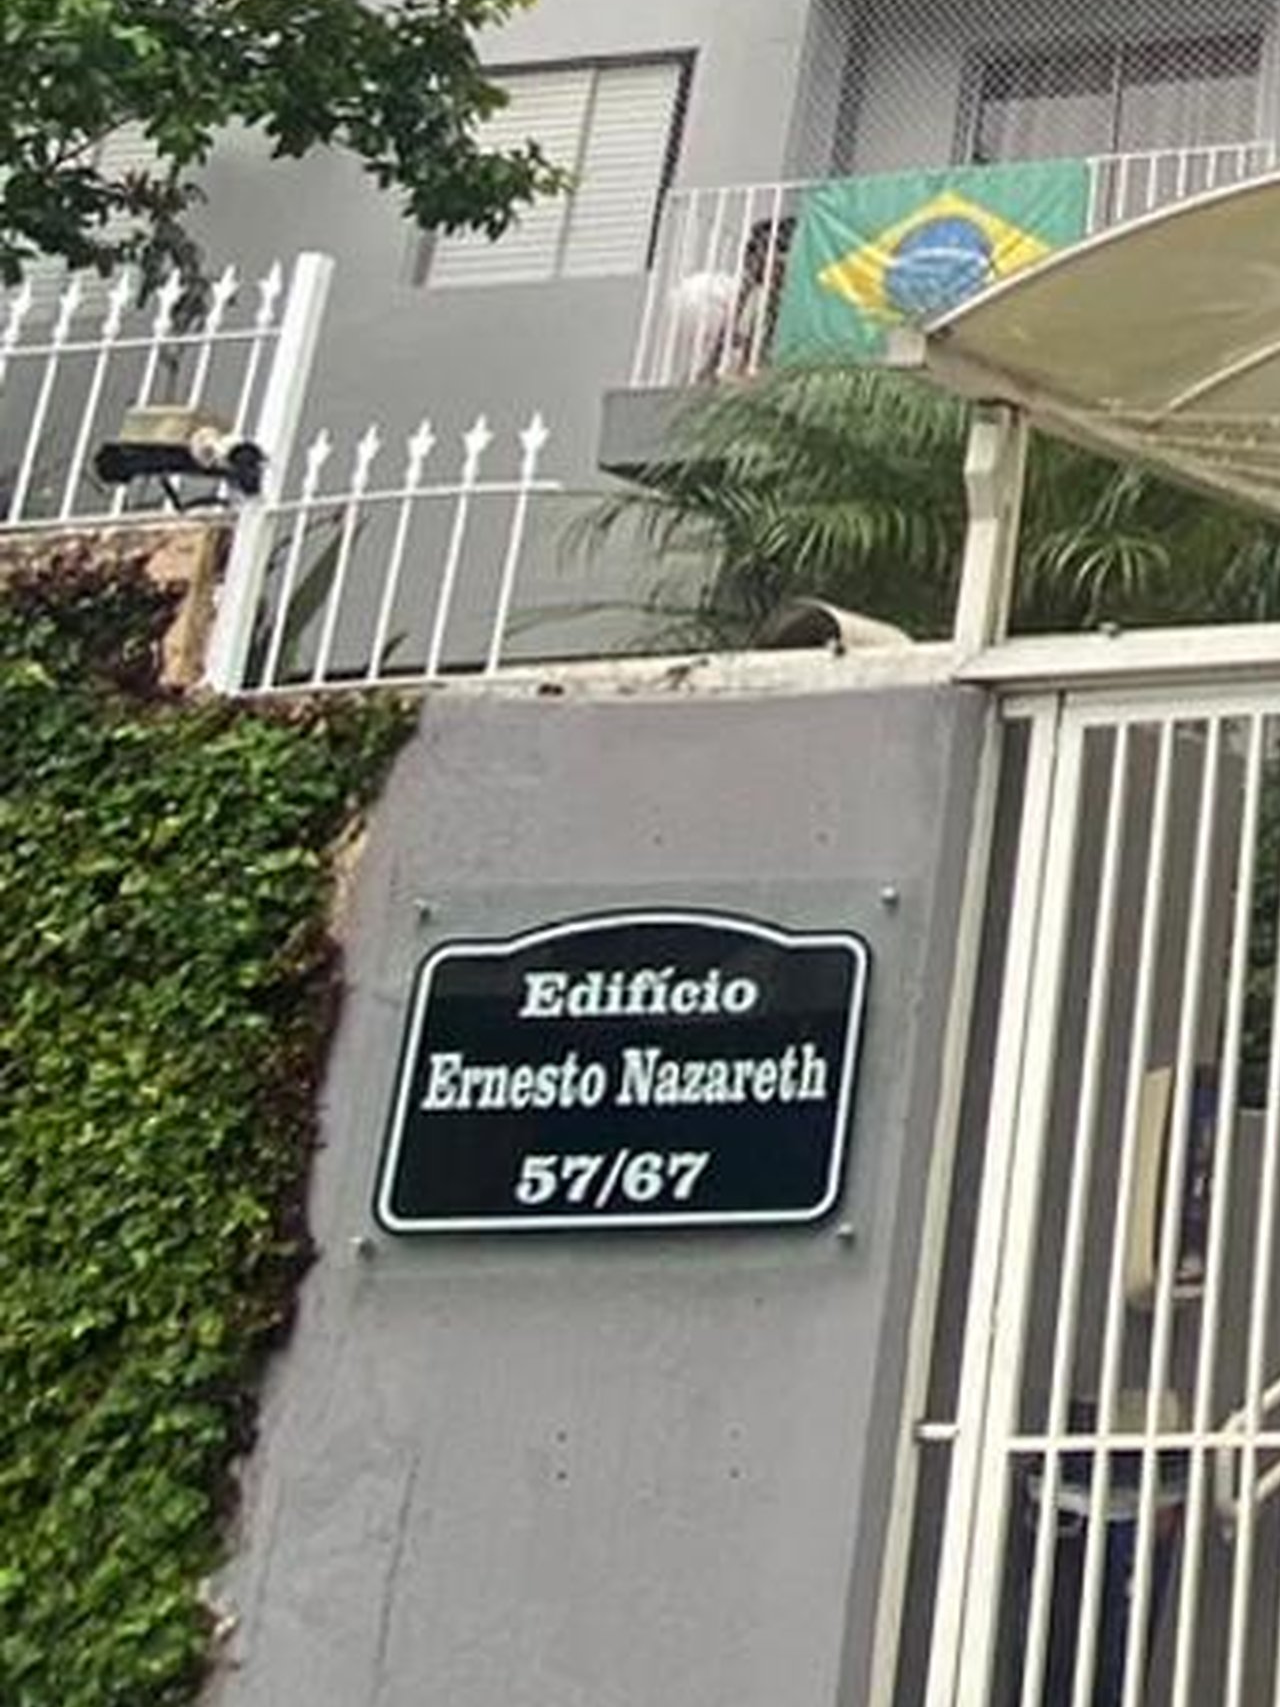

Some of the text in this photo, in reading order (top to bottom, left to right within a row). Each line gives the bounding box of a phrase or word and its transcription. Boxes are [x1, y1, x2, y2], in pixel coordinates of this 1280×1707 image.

[519, 966, 759, 1018] Edifício
[421, 1042, 828, 1110] Ernesto Nazareth
[515, 1149, 711, 1208] 57/67
